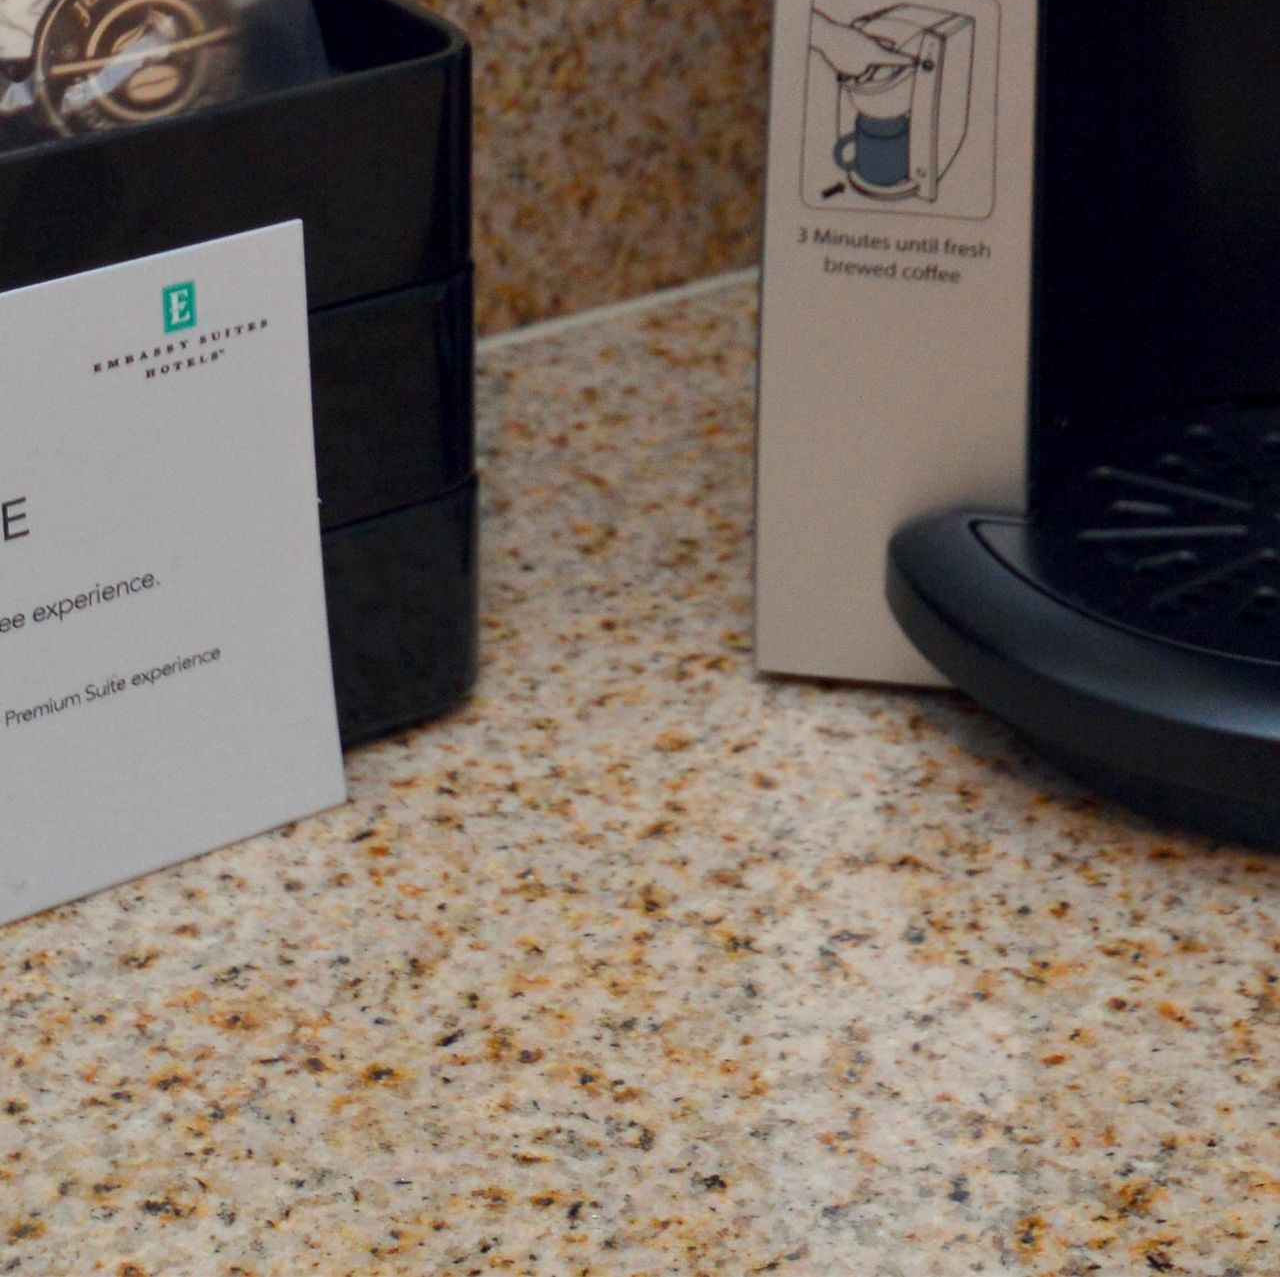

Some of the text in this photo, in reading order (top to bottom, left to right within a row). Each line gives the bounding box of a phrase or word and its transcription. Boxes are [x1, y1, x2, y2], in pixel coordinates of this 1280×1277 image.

[796, 227, 992, 259] 3 Minutes until fresh
[823, 256, 962, 284] brewed coffee
[93, 319, 269, 374] EMBASSY SUITES
[32, 571, 161, 622] experience.
[4, 690, 81, 728] Premium
[85, 673, 127, 703] Suite
[131, 647, 222, 686] experience
